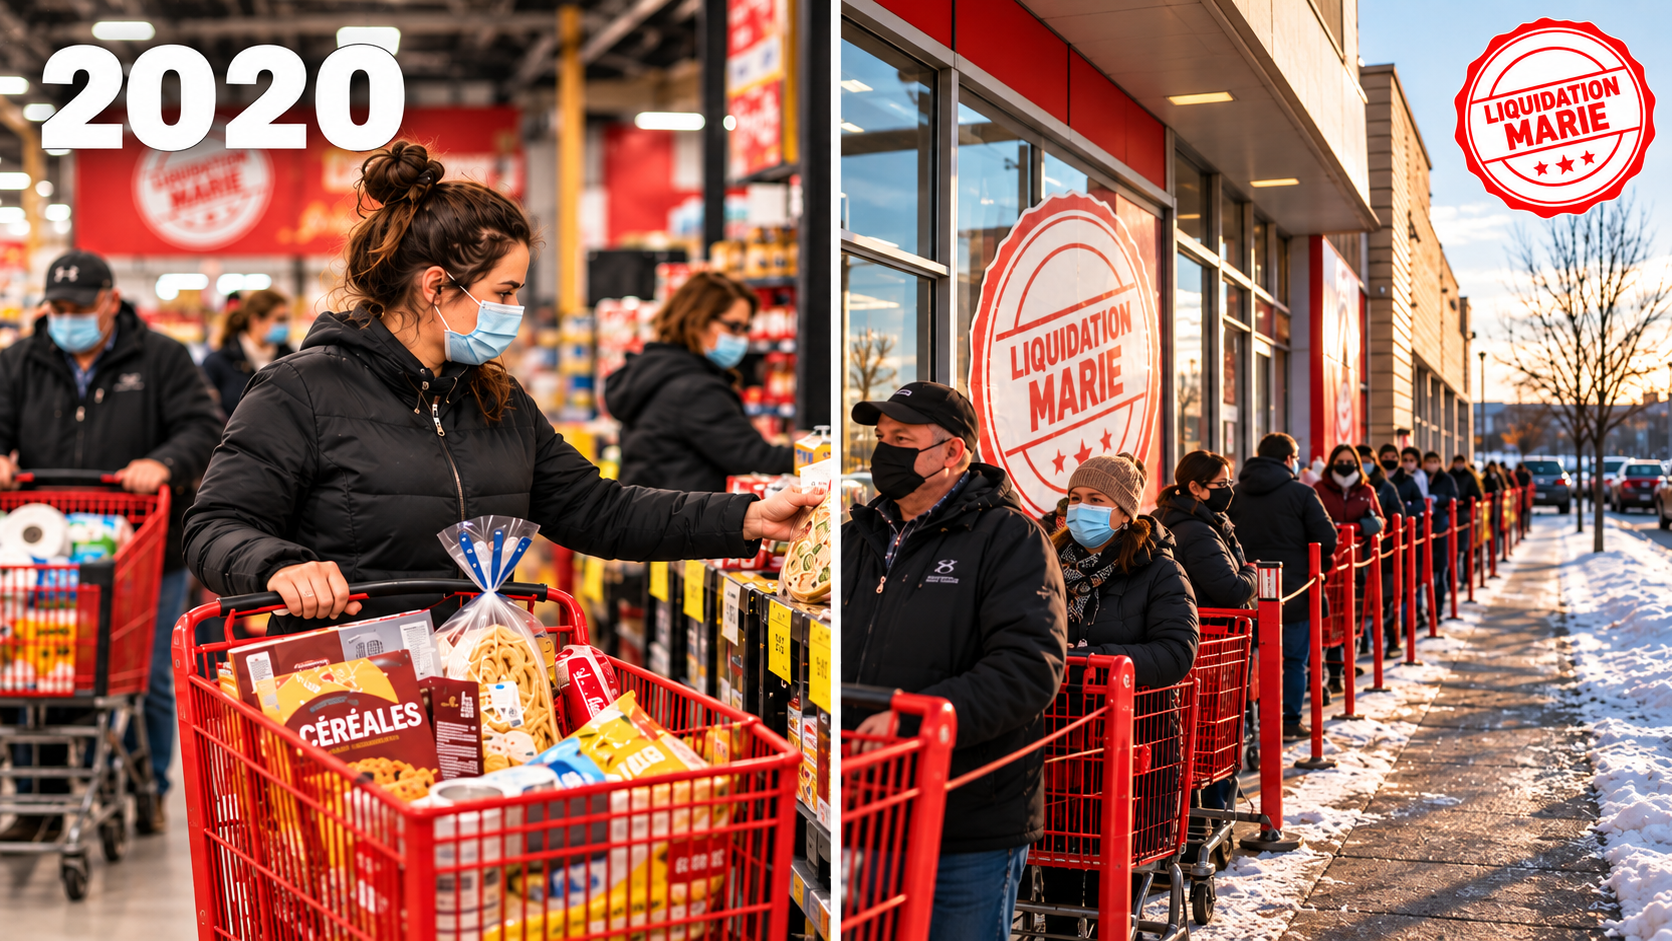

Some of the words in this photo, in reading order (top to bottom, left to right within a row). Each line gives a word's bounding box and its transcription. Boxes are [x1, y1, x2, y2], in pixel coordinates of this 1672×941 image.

[170, 173, 244, 208] MARIE
[1010, 301, 1132, 381] LIQUIDATION
[1028, 344, 1125, 433] MARIE
[298, 702, 422, 747] CÉRÉALES
